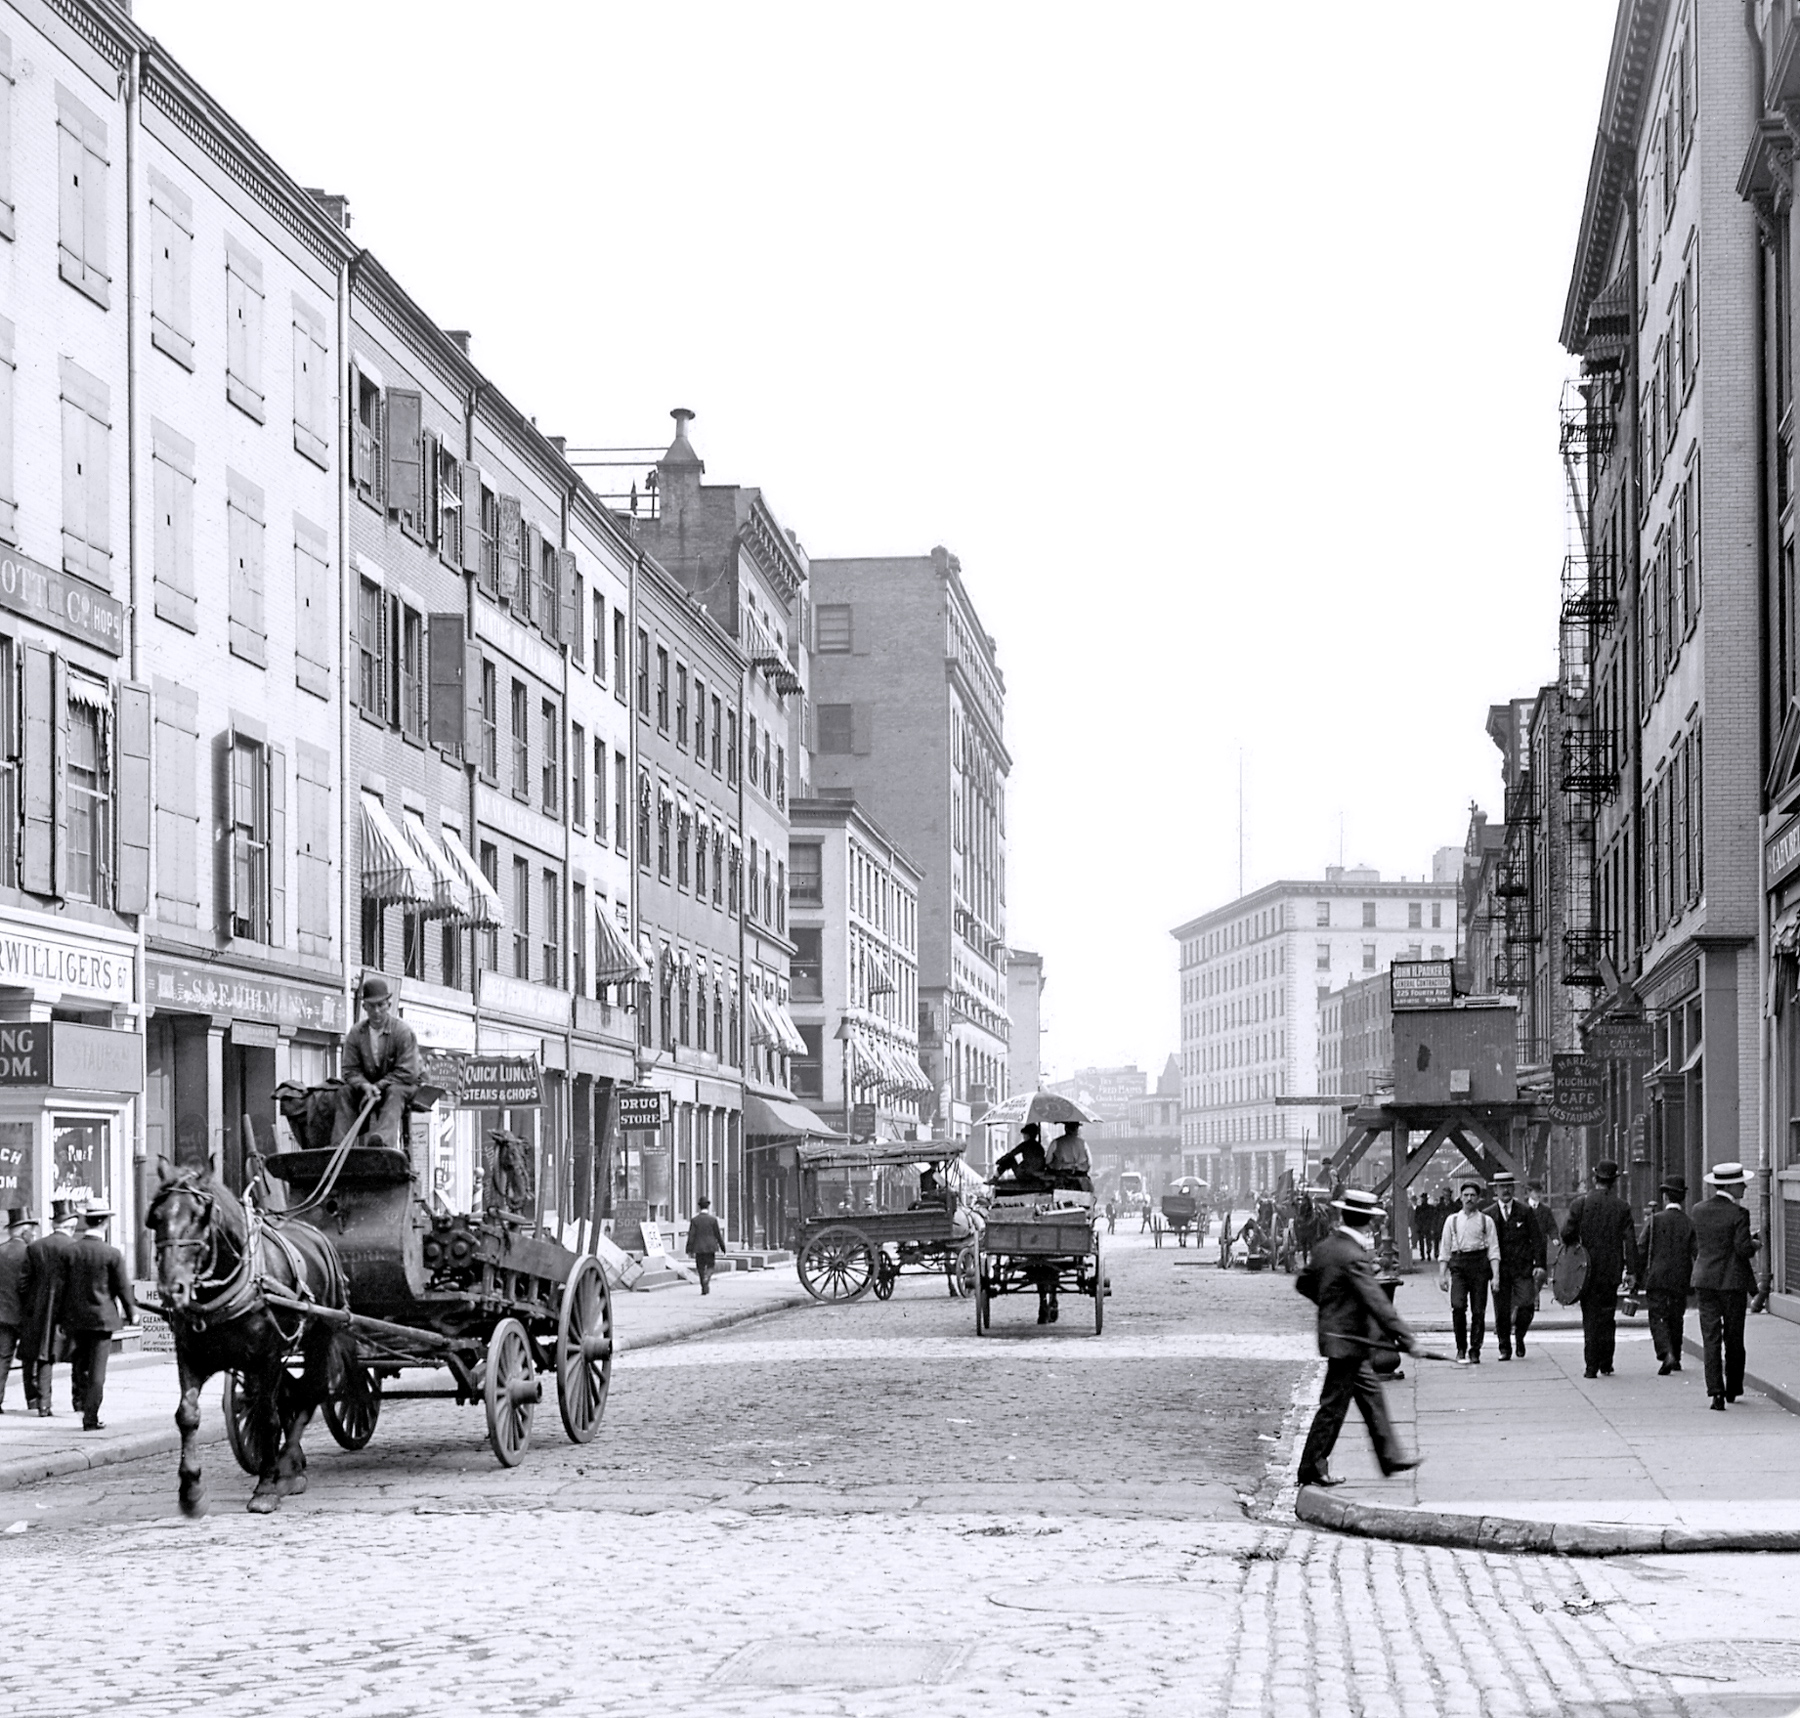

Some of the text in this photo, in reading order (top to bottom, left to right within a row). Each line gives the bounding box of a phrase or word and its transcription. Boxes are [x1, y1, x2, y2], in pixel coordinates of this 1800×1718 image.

[94, 605, 120, 639] HOPS
[465, 1065, 498, 1085] QUICK
[1574, 1066, 1582, 1076] &
[463, 1088, 498, 1101] STEAKS
[506, 1086, 538, 1101] CHOPS
[620, 1097, 658, 1109] DRUG
[1548, 1104, 1605, 1123] RESTAURANT
